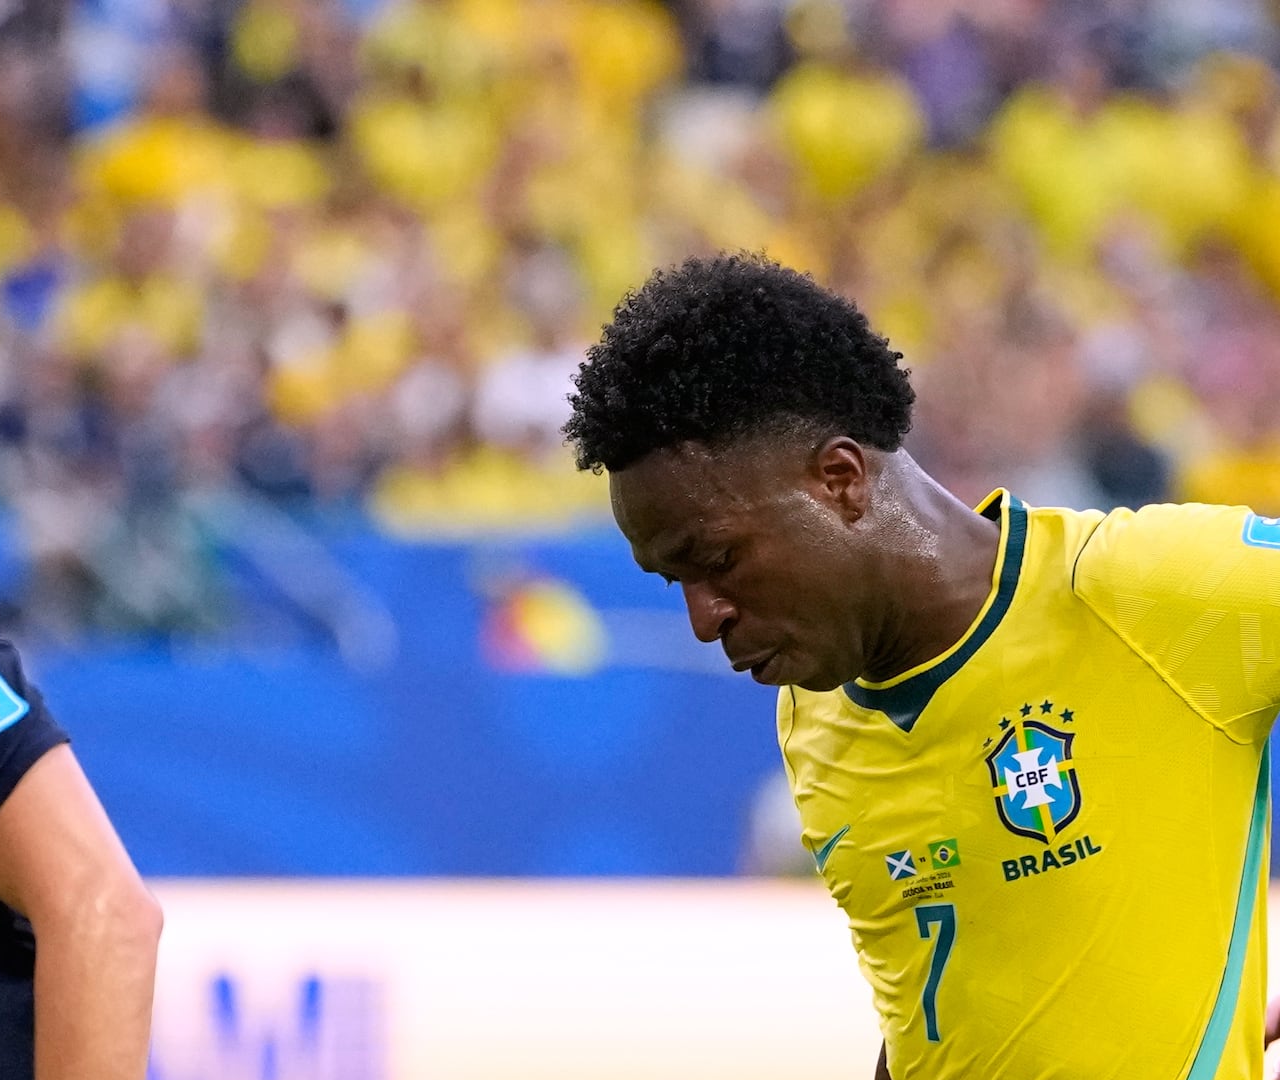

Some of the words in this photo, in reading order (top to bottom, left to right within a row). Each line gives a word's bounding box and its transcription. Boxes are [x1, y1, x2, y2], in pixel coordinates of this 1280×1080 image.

[1015, 768, 1049, 789] CBF
[1002, 835, 1102, 882] BRASIL
[915, 904, 956, 1042] 7
